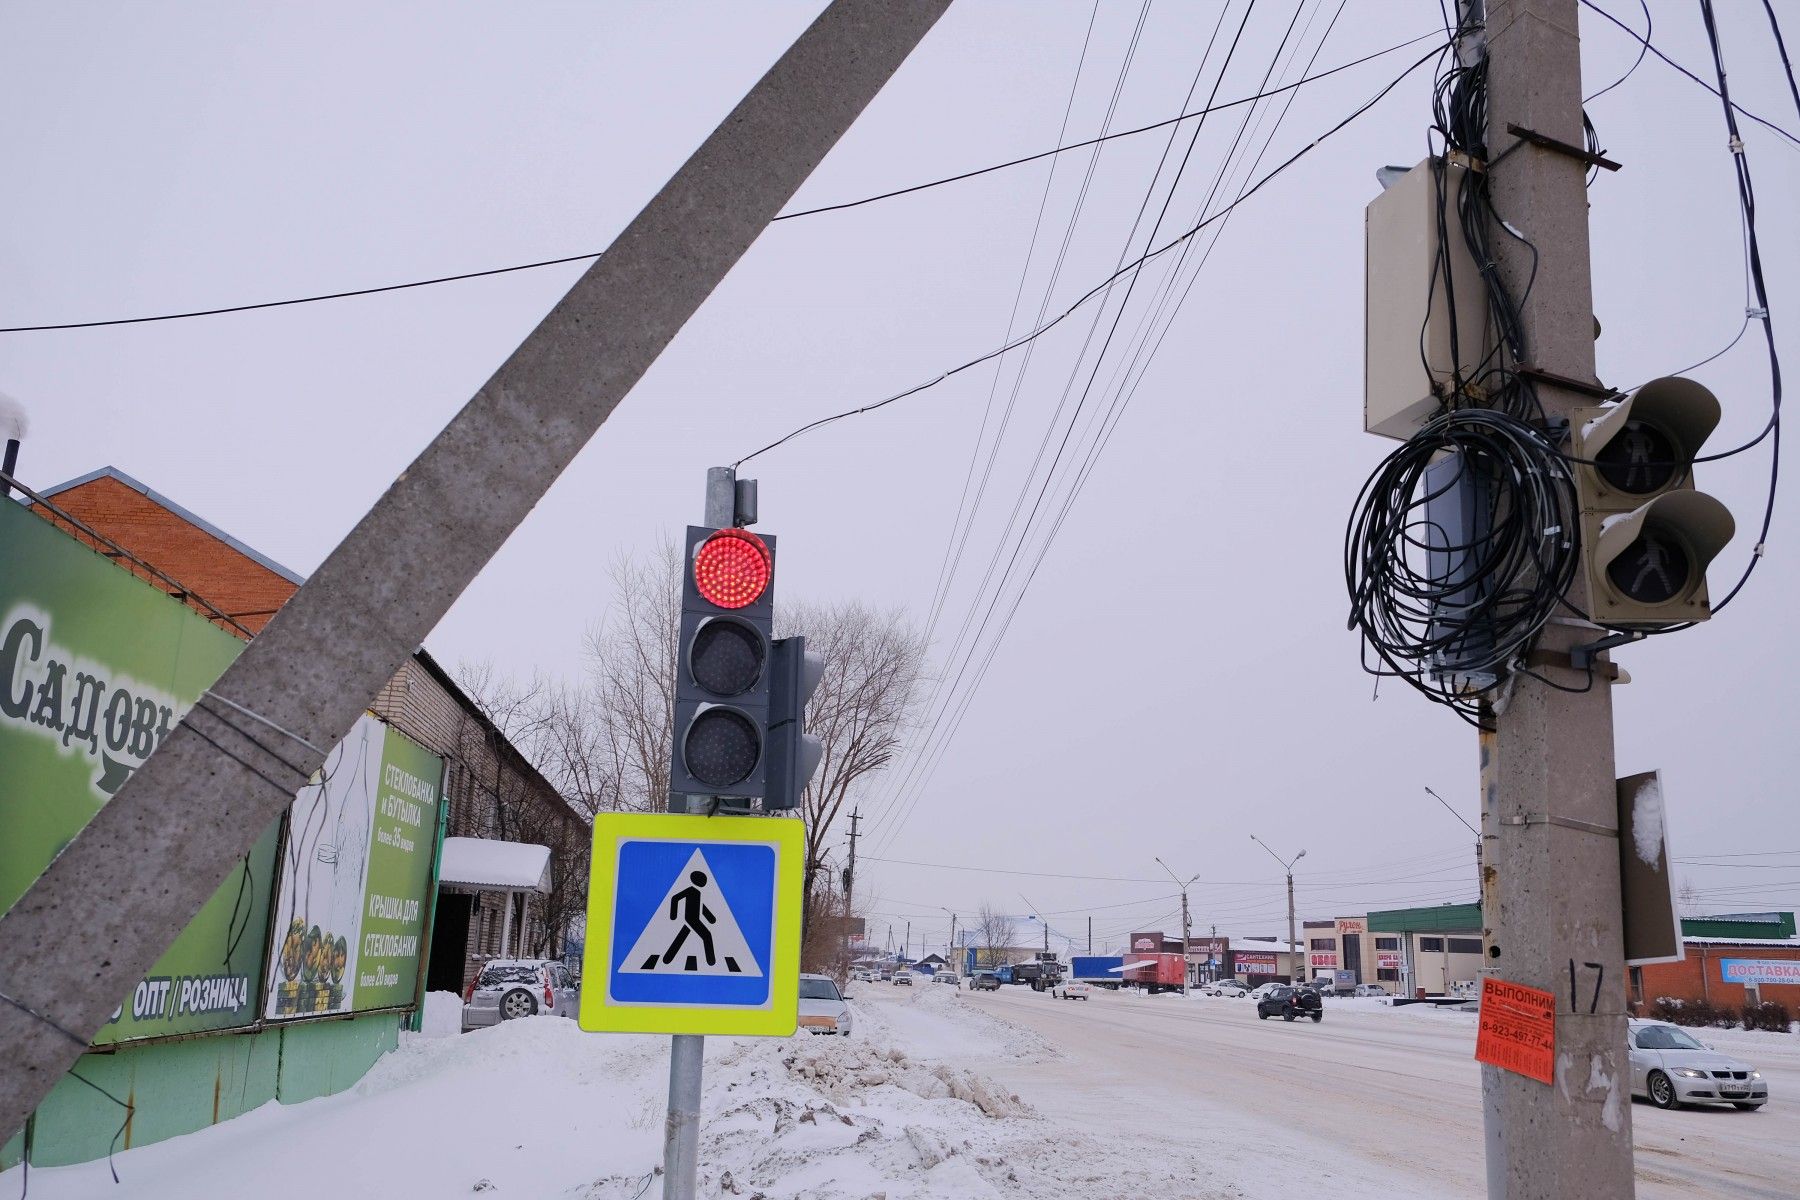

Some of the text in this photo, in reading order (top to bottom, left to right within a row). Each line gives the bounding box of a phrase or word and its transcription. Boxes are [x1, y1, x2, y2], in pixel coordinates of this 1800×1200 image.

[384, 763, 434, 806] СТЕКЛОБАНКА
[387, 795, 421, 828] БУТЫЛКА
[377, 826, 414, 852] более 35 видов
[368, 893, 419, 925] КРЫШКА ДЛЯ
[364, 933, 418, 957] СТЕКЛОБАНКИ
[360, 965, 399, 987] более 20 видов
[1569, 957, 1604, 1013] 17
[1728, 964, 1800, 976] ДОСТАВКА
[133, 980, 171, 1017] ОПТ
[178, 977, 248, 1012] РОЗНИЦА
